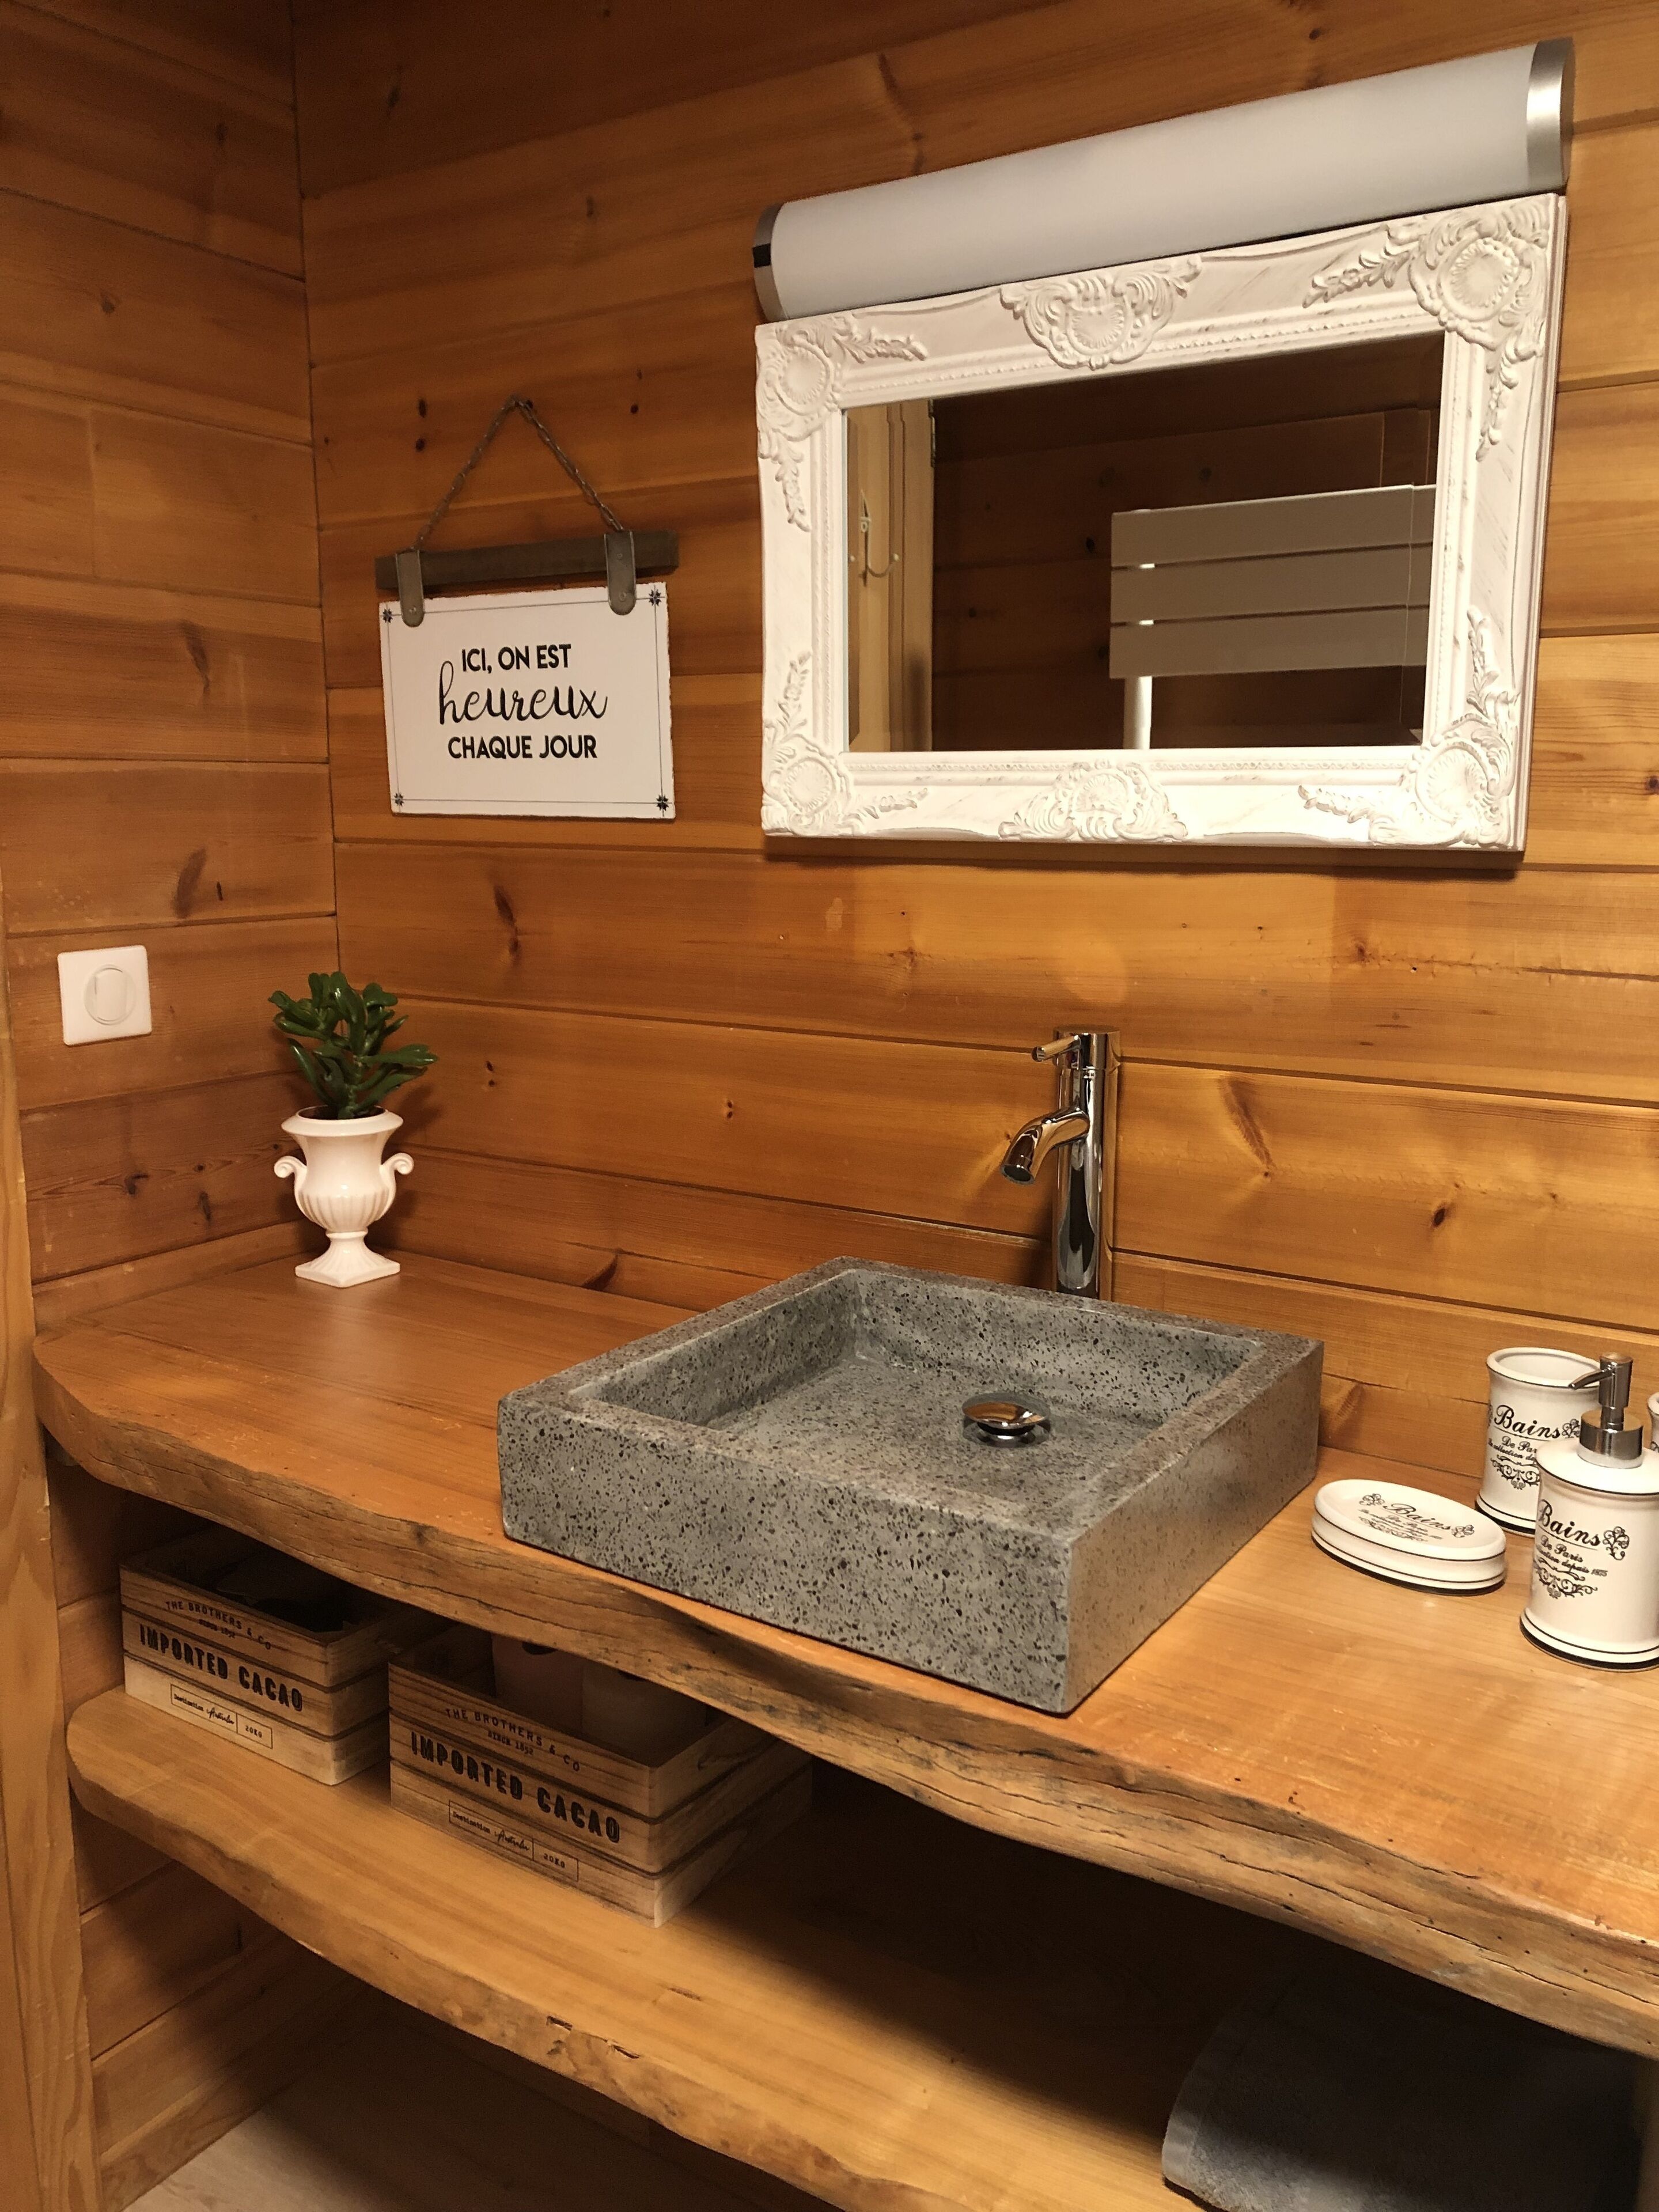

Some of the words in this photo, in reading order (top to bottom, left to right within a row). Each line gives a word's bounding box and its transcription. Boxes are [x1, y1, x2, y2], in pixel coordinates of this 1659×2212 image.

[461, 649, 492, 674] ICI,
[498, 645, 529, 670] ON
[537, 643, 571, 669] EST
[438, 660, 608, 725] heureux
[448, 735, 533, 759] CHAQUE
[539, 734, 597, 759] JOUR
[1494, 1404, 1560, 1439] Bains
[1517, 1441, 1537, 1453] Par
[1382, 1503, 1451, 1530] Bains
[1538, 1499, 1601, 1547] Bains
[1554, 1543, 1584, 1563] Paris
[165, 1601, 184, 1611] THE
[188, 1603, 242, 1630] BROTHERS
[139, 1624, 229, 1680] IMPORTED
[238, 1665, 303, 1712] CACAO
[445, 1709, 468, 1719] THE
[474, 1711, 543, 1747] BROTHERS
[548, 1744, 556, 1755] &
[563, 1754, 580, 1772] CO
[410, 1730, 523, 1801] IMPORTED
[537, 1787, 620, 1843] CACAO
